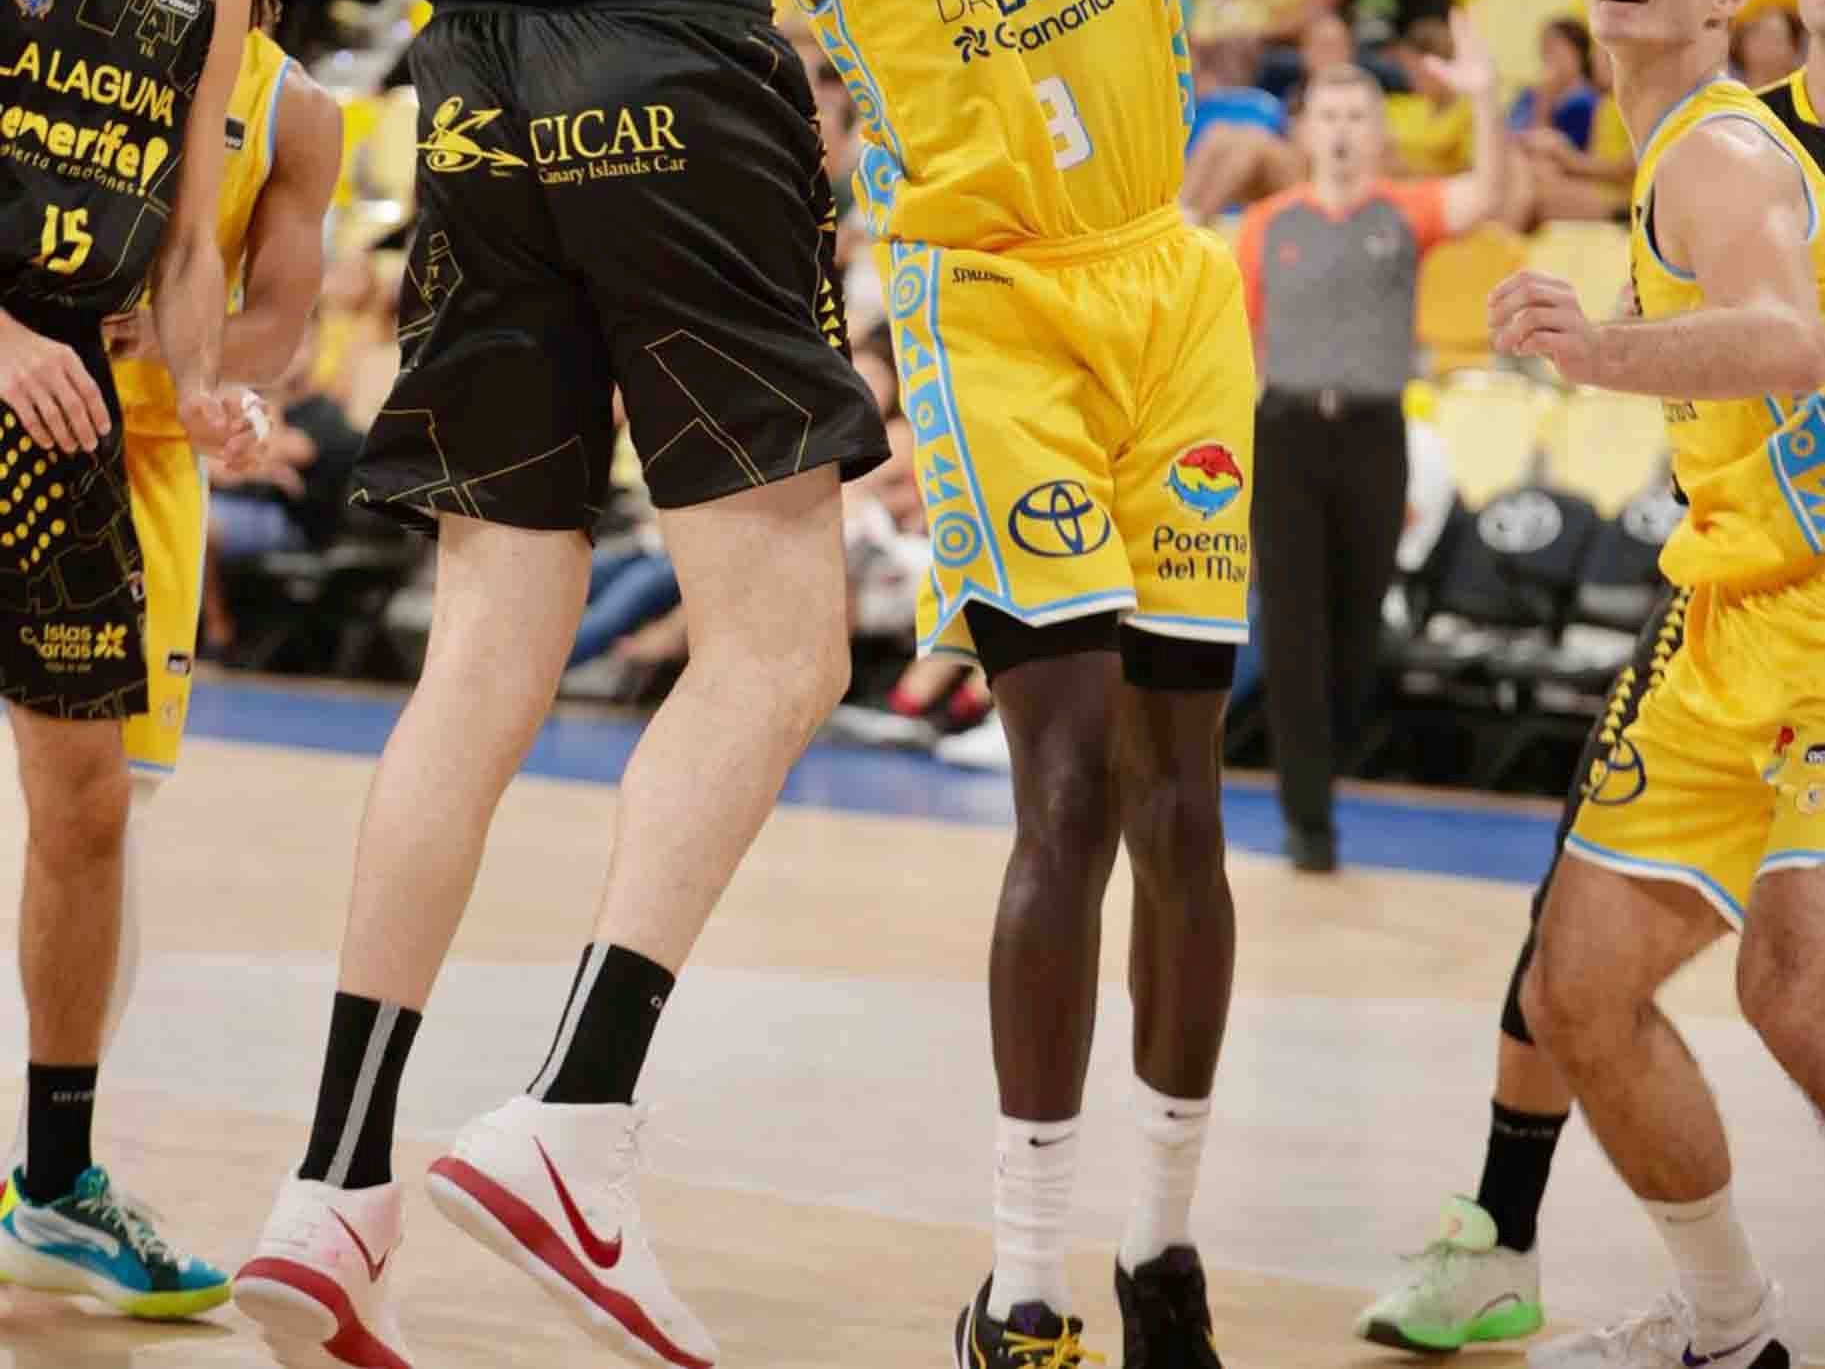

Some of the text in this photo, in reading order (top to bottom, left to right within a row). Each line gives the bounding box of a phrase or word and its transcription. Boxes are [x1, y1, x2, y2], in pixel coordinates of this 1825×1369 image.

[47, 49, 174, 127] LAGUNA
[0, 104, 169, 197] enerife!
[530, 104, 686, 164] CICAR
[588, 155, 649, 179] Islands
[653, 154, 688, 173] Car
[41, 204, 93, 274] 15
[1158, 557, 1195, 579] del
[44, 623, 92, 642] Islas
